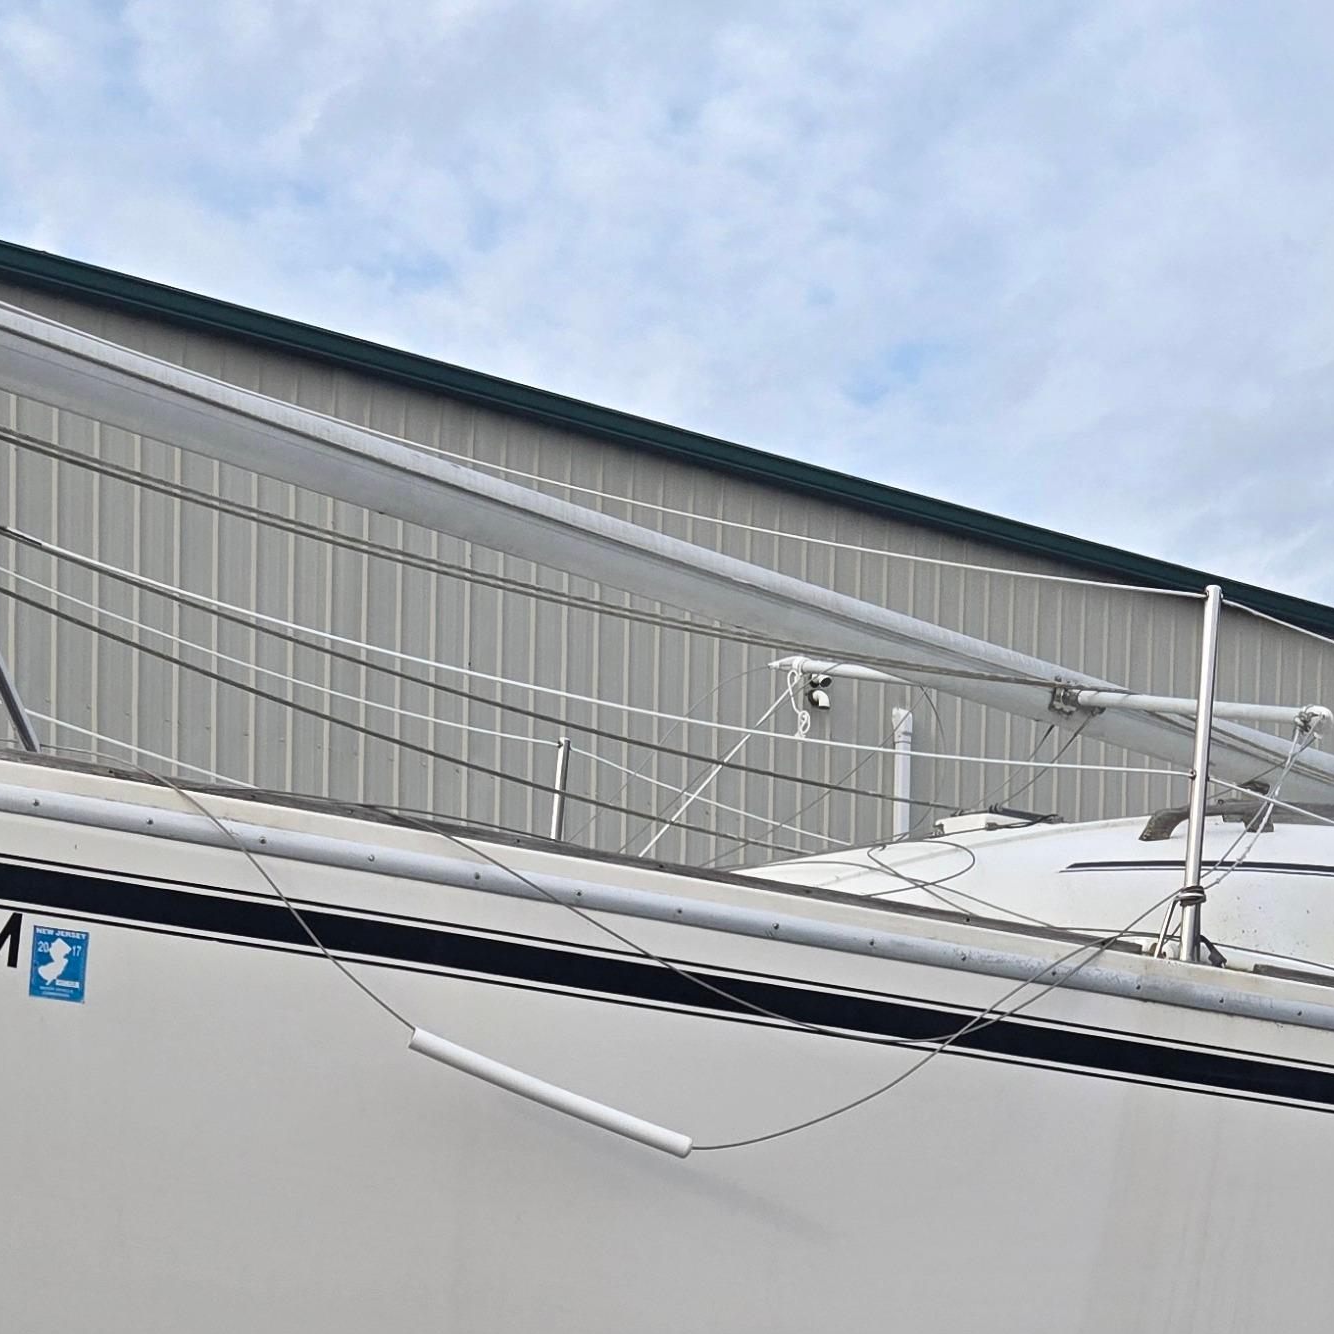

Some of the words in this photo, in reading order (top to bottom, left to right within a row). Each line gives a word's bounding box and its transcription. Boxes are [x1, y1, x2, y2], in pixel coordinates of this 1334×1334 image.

[35, 927, 54, 936] NEW
[55, 930, 86, 939] JERSEY
[37, 941, 50, 953] 20
[72, 945, 82, 957] 17
